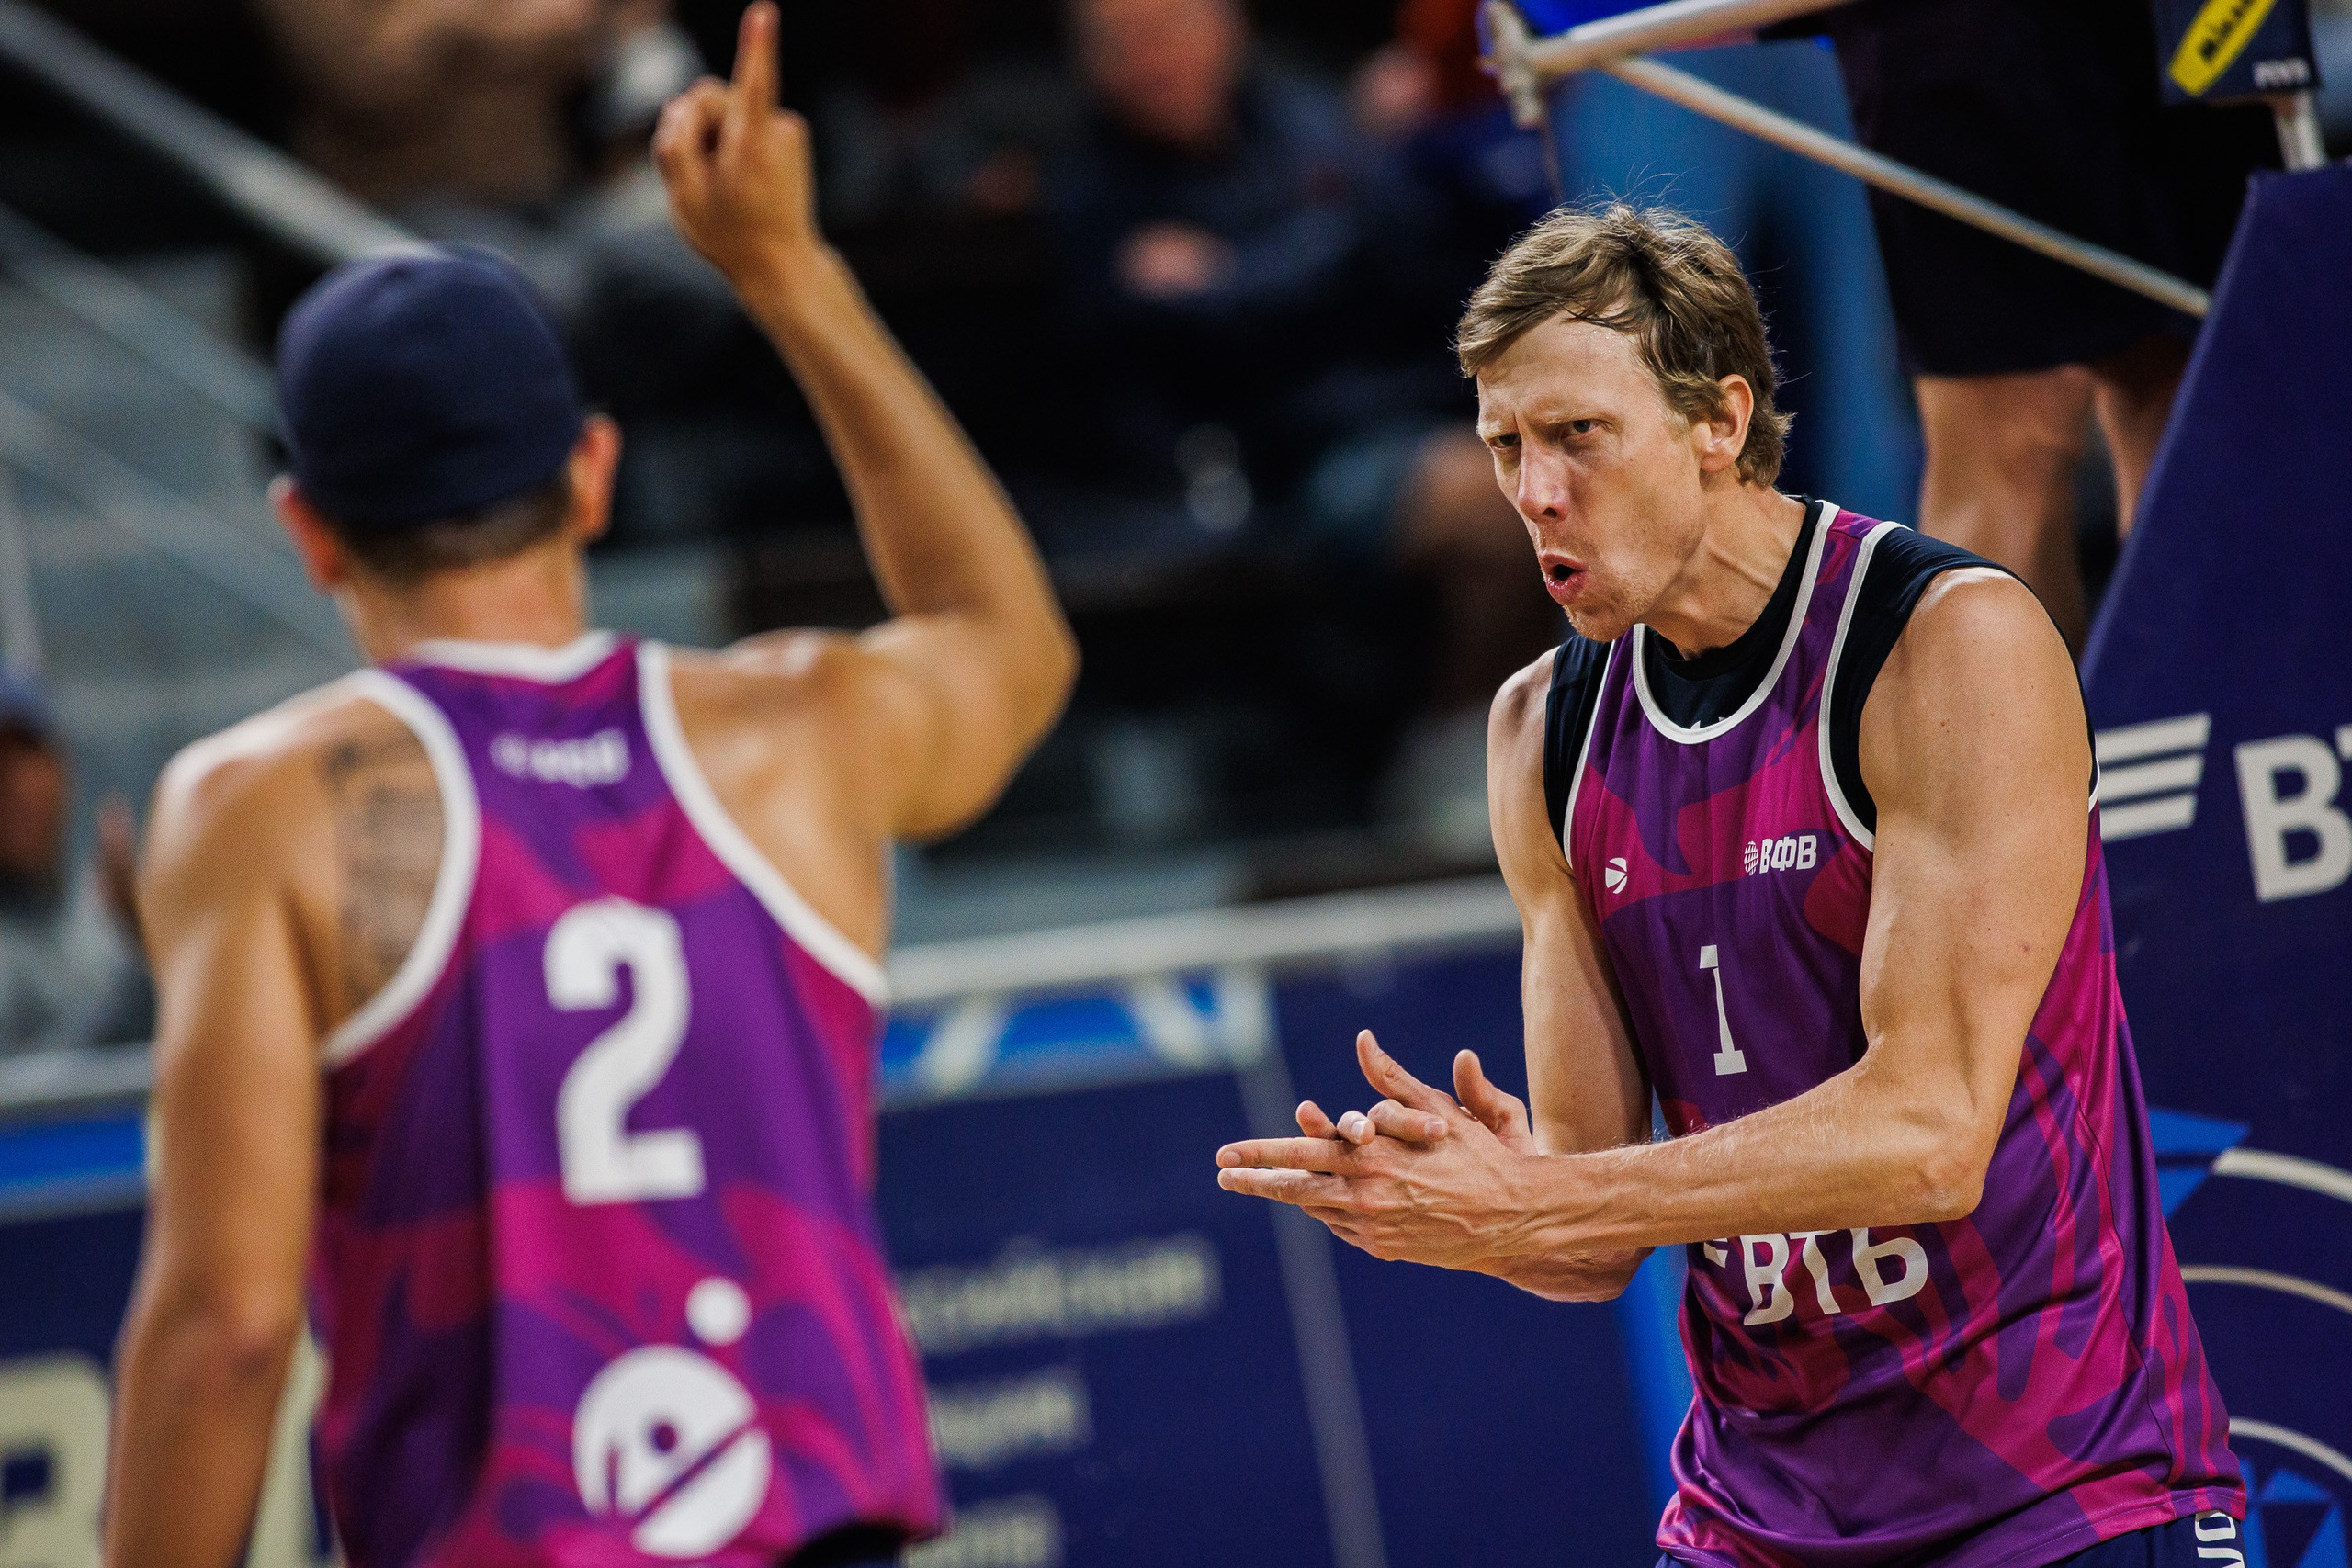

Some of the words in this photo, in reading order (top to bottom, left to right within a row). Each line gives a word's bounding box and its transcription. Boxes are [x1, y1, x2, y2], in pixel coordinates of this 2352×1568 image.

[1759, 835, 1817, 874] ВФВ
[2233, 722, 2352, 903] В
[544, 896, 707, 1205] 2
[1699, 944, 1747, 1076] 1
